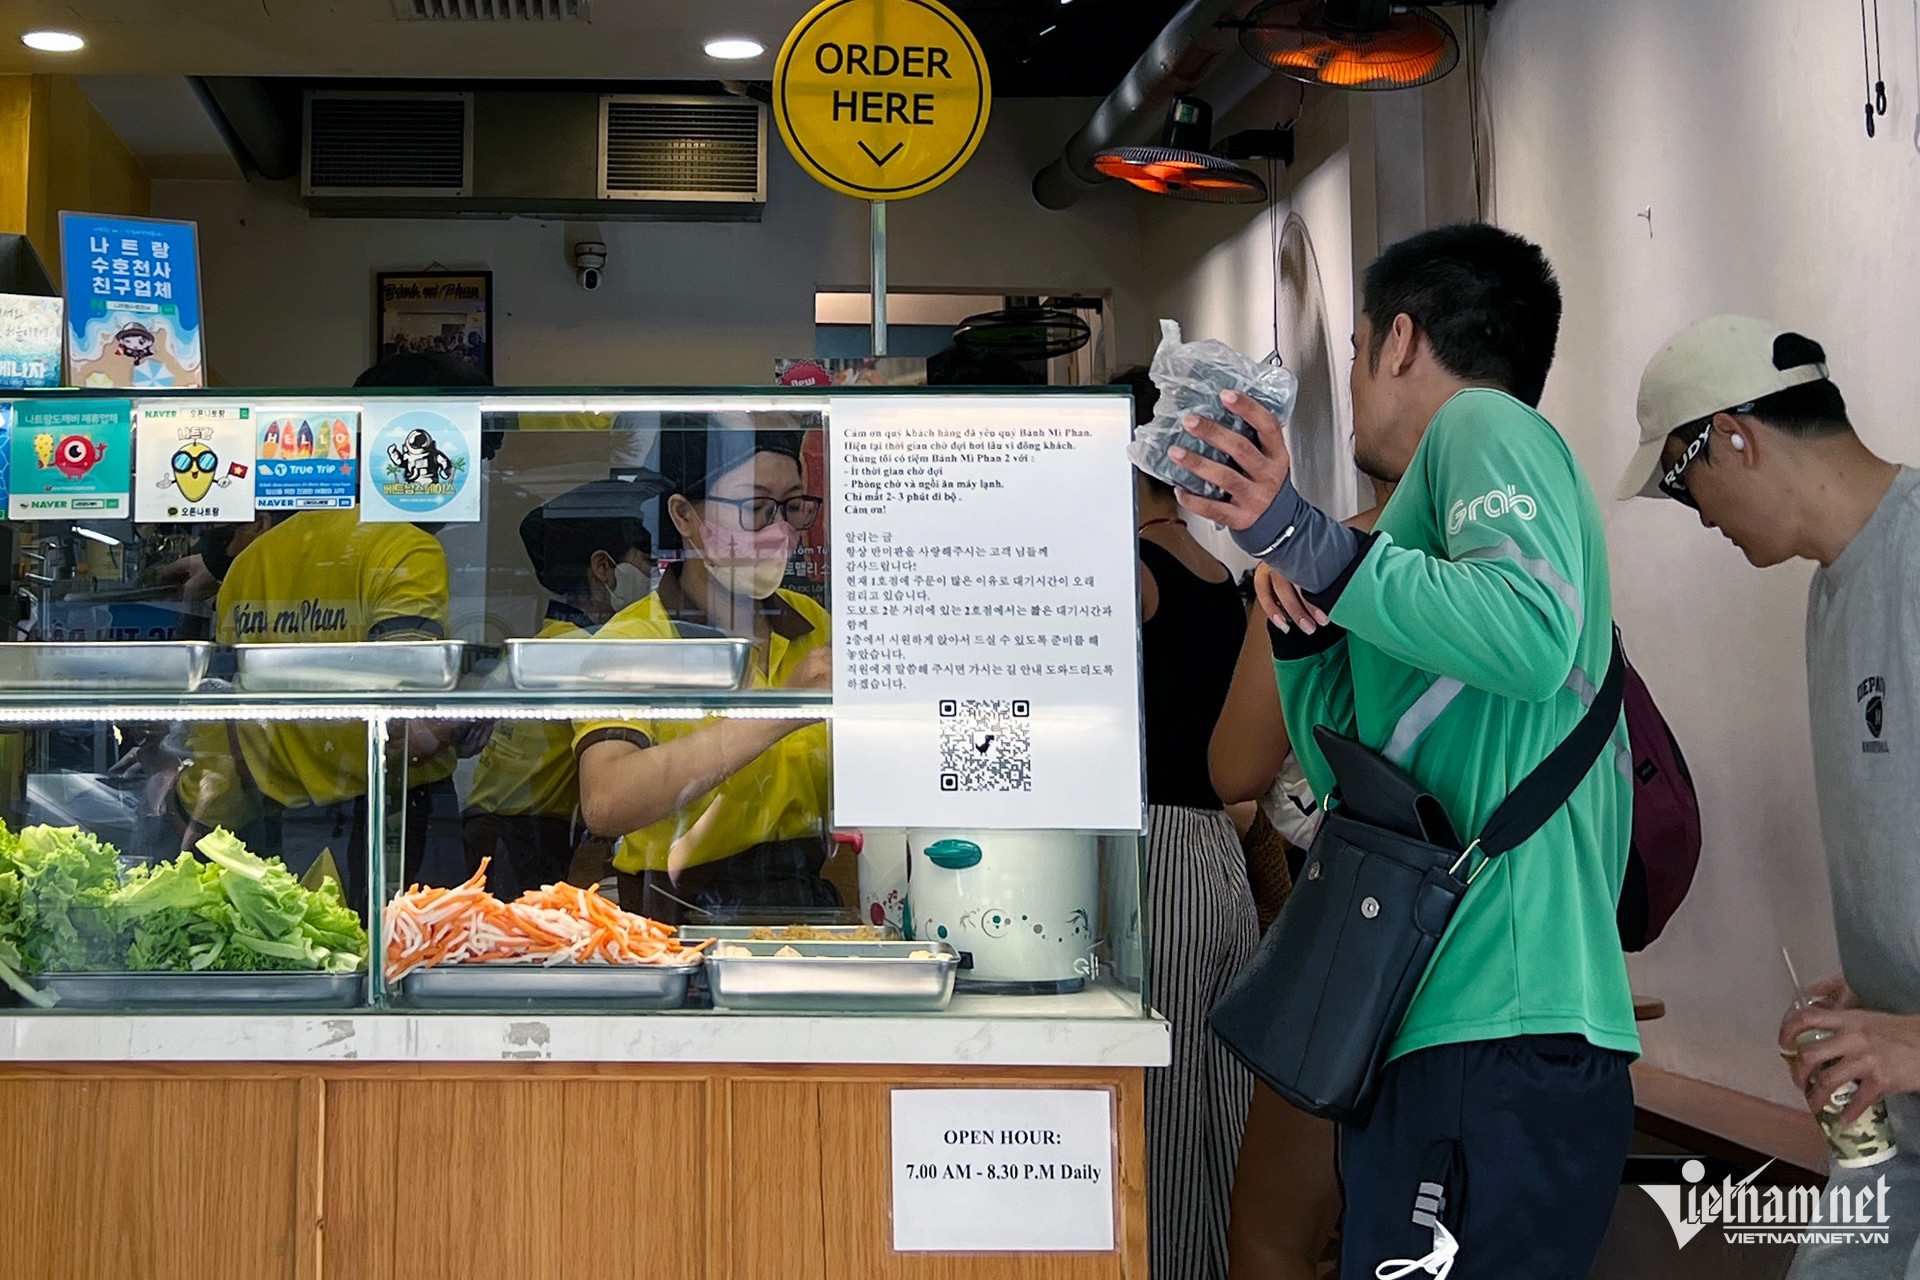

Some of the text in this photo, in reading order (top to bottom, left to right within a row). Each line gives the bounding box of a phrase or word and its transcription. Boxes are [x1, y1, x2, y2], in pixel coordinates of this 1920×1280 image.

[815, 42, 952, 79] ORDER
[832, 90, 935, 125] HERE
[91, 256, 172, 280] 수호천사
[92, 276, 173, 299] 친구업체
[145, 410, 177, 418] NAVER
[267, 433, 347, 444] HELLO
[1664, 424, 1711, 486] RUDY
[31, 501, 67, 509] NAVER
[258, 499, 294, 507] NAVER
[1448, 484, 1537, 535] Grab
[944, 1130, 1061, 1145] OPEN HOUR:
[906, 1164, 937, 1179] 7.00
[942, 1164, 971, 1179] AM
[987, 1164, 1018, 1179] 8.30
[1024, 1164, 1054, 1179] P.M
[1061, 1164, 1101, 1183] Daily
